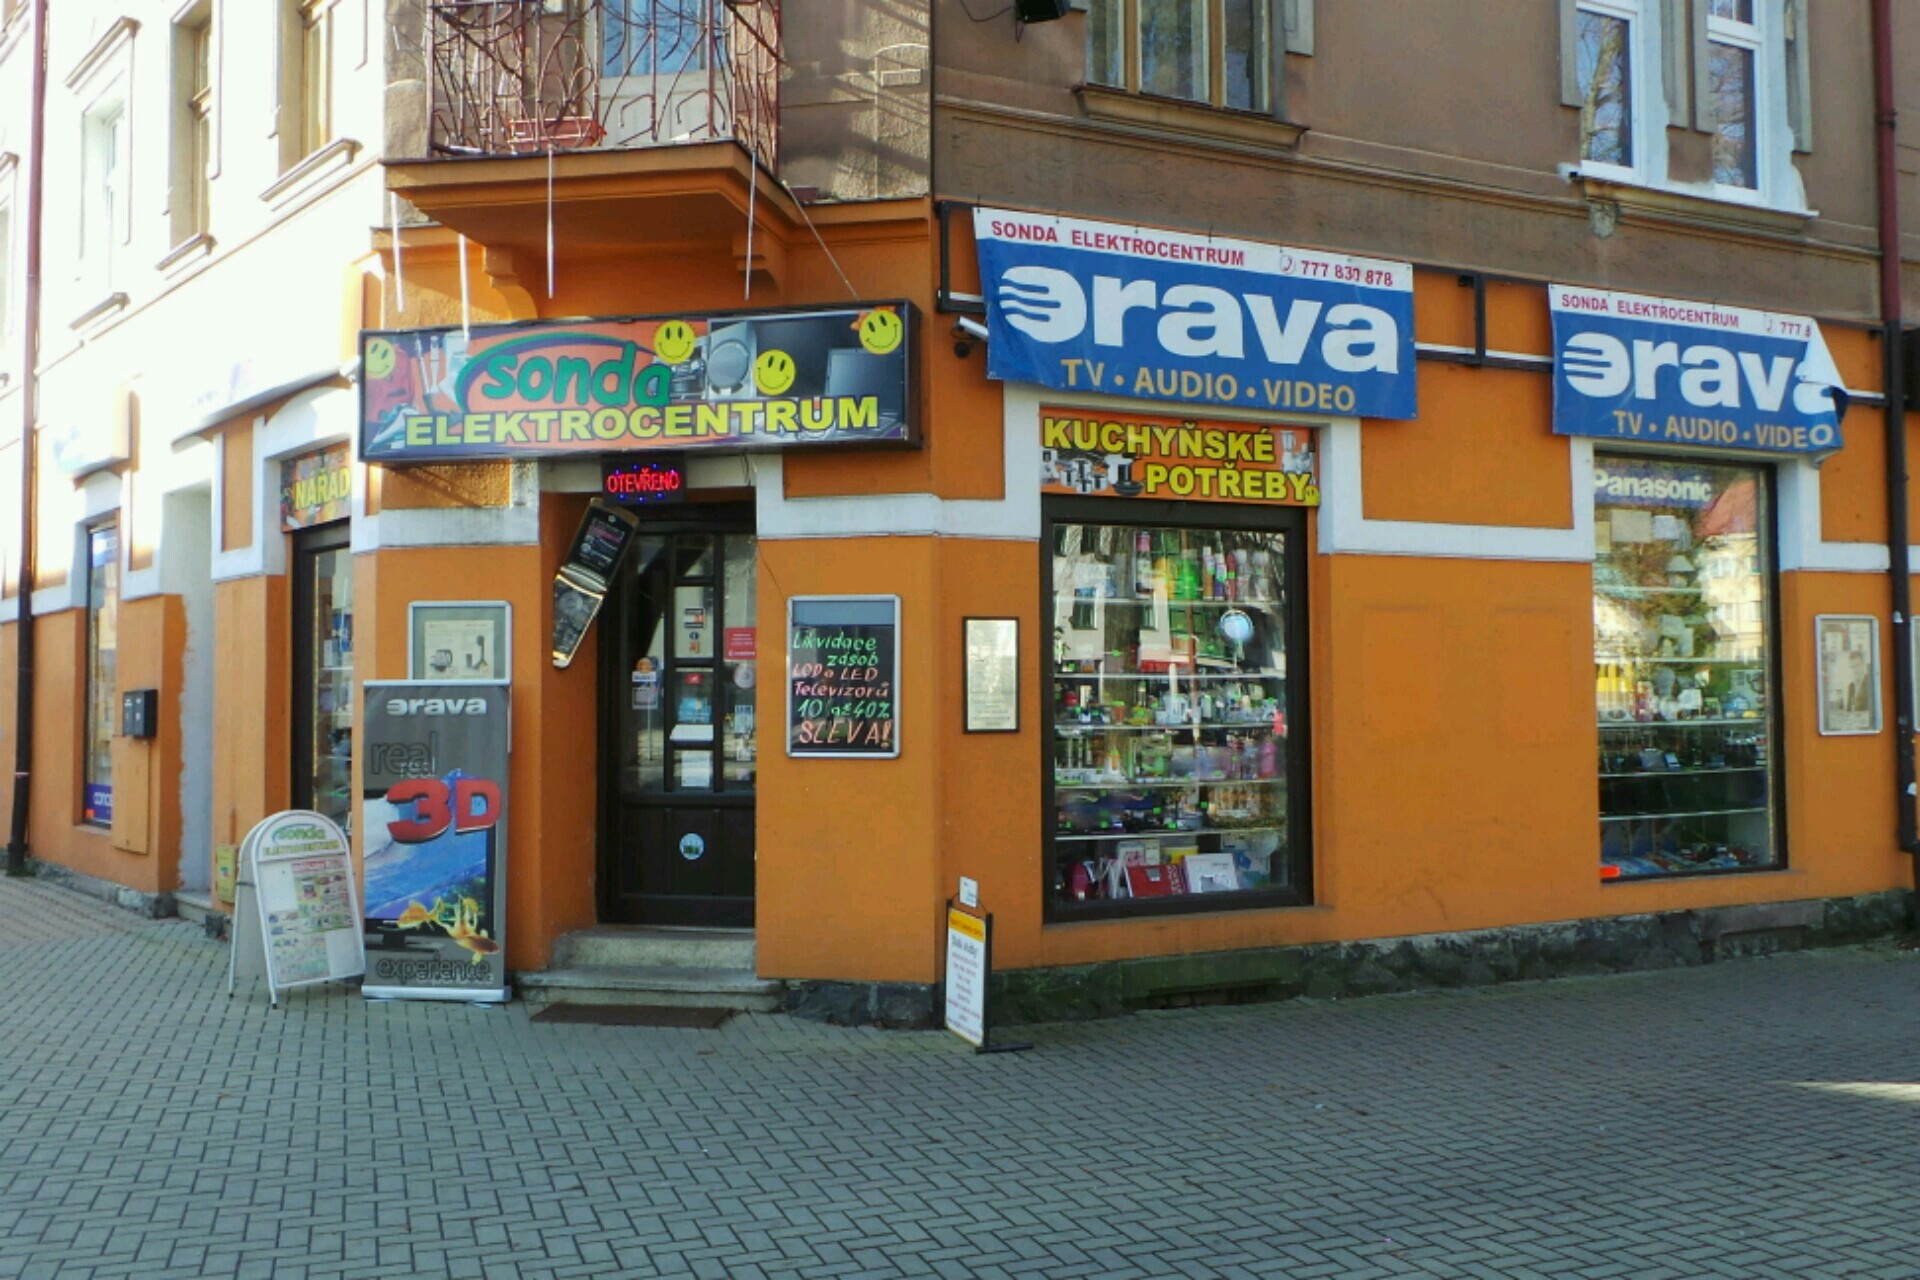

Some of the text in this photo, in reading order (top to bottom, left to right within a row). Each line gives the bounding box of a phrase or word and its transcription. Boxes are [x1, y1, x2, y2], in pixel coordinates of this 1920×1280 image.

[991, 220, 1058, 243] SONDA
[1071, 230, 1245, 267] ELEKTROCENTRUM
[1300, 260, 1329, 277] 777
[1364, 269, 1393, 287] 878
[1561, 293, 1608, 312] SONDA
[1617, 299, 1740, 328] ELEKTROCENTRUM
[1780, 320, 1802, 335] 777
[482, 342, 673, 407] sonda
[1060, 358, 1356, 411] TV AUDIO VIDEO
[405, 396, 880, 446] ELEKTROCENTRUM
[1043, 417, 1276, 462] KUCHYŇSKÉ
[1613, 410, 1834, 449] TV AUDIO VIDEO
[606, 467, 682, 494] OTEVŘENO
[1146, 462, 1312, 501] POTŘEBY
[1593, 470, 1713, 502] Panasonic
[792, 630, 877, 651] Likvidace
[840, 667, 878, 681] LED
[798, 698, 823, 718] 10
[371, 731, 437, 776] real
[387, 777, 503, 845] 3D
